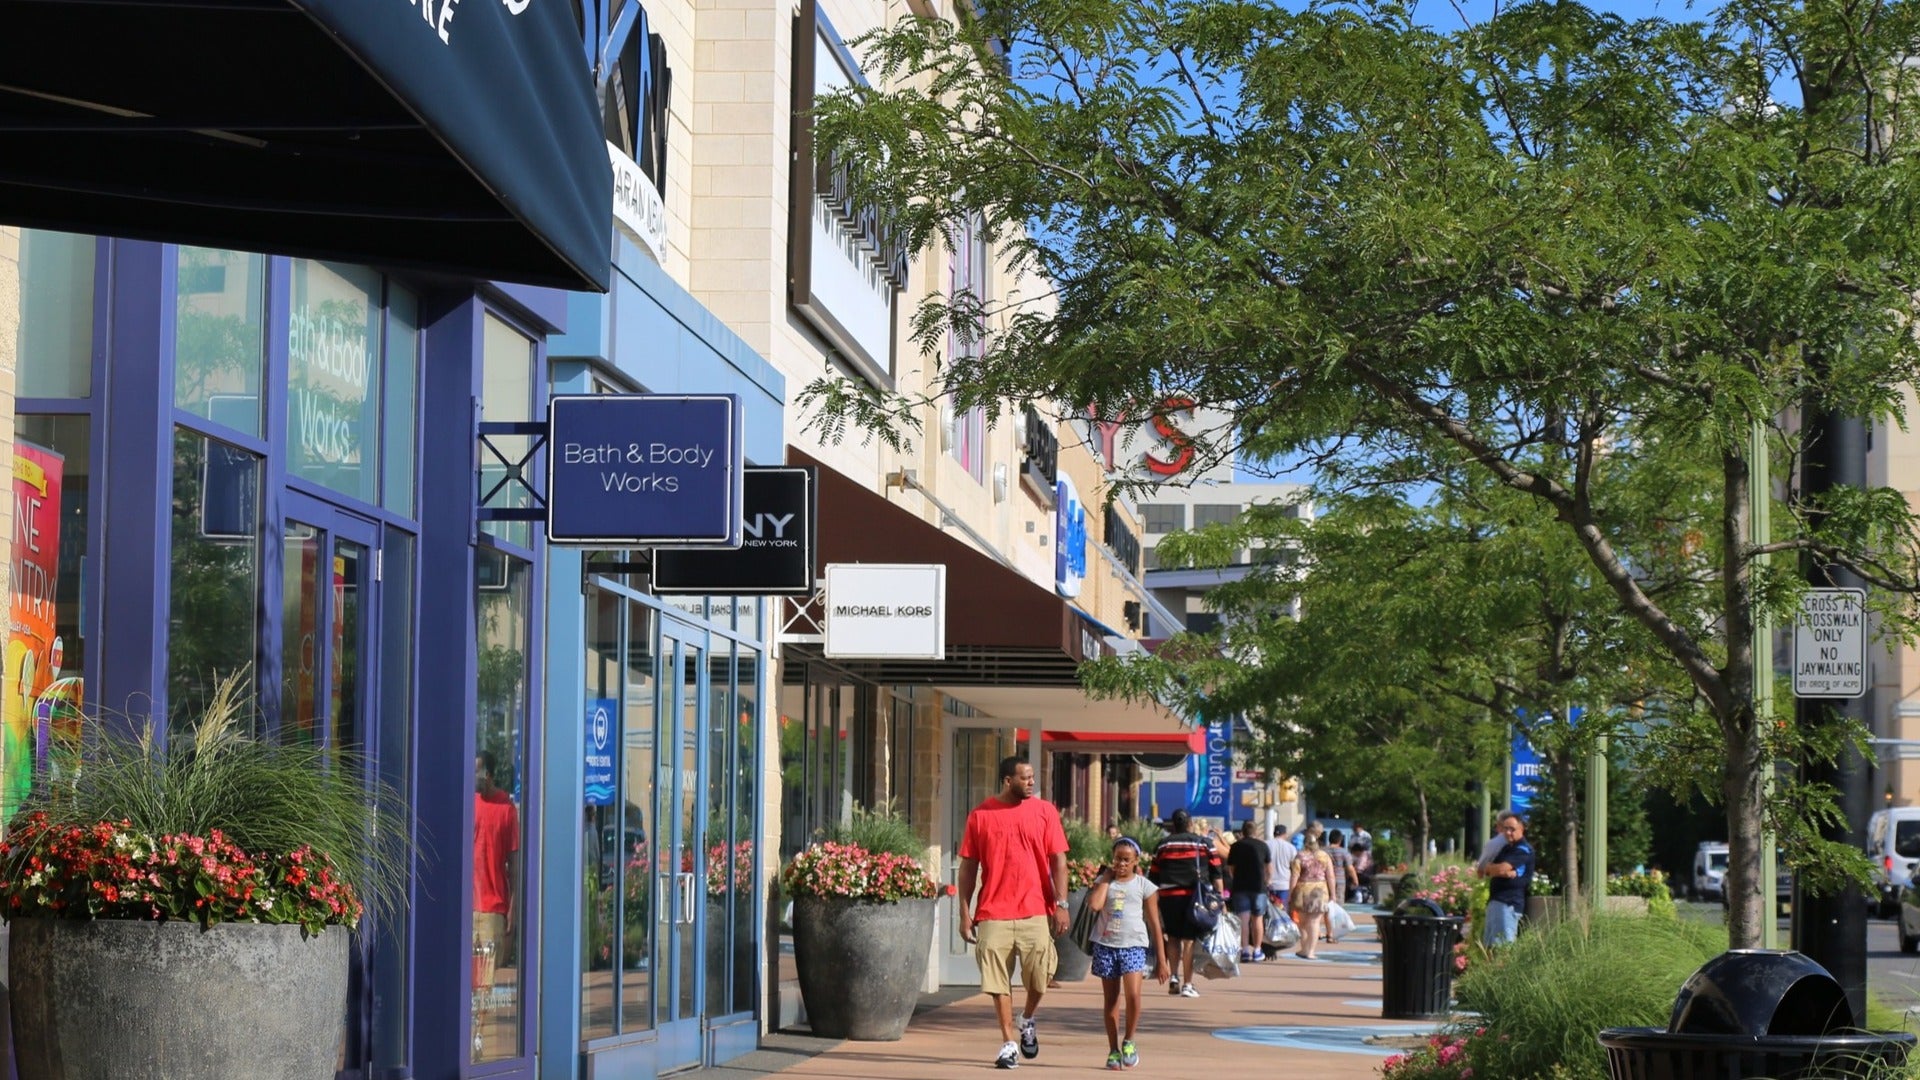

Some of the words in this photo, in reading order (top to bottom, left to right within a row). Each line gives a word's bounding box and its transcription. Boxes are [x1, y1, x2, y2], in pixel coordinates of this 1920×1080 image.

[612, 161, 646, 222] ARAN
[288, 304, 315, 365] ath
[318, 315, 330, 372] &
[332, 320, 372, 402] Body
[299, 387, 350, 463] Works
[564, 443, 622, 464] Bath
[626, 443, 644, 464] &
[649, 443, 714, 468] Body
[600, 471, 679, 492] Works
[743, 513, 795, 538] NY
[744, 539, 766, 547] NEW
[768, 539, 798, 547] YORK
[835, 605, 893, 617] MICHAEL
[896, 605, 933, 617] KORS
[1805, 598, 1839, 612] CROSS
[1815, 628, 1844, 642] ONLY
[1821, 647, 1838, 660] NO
[1799, 662, 1860, 676] JAYWALKING
